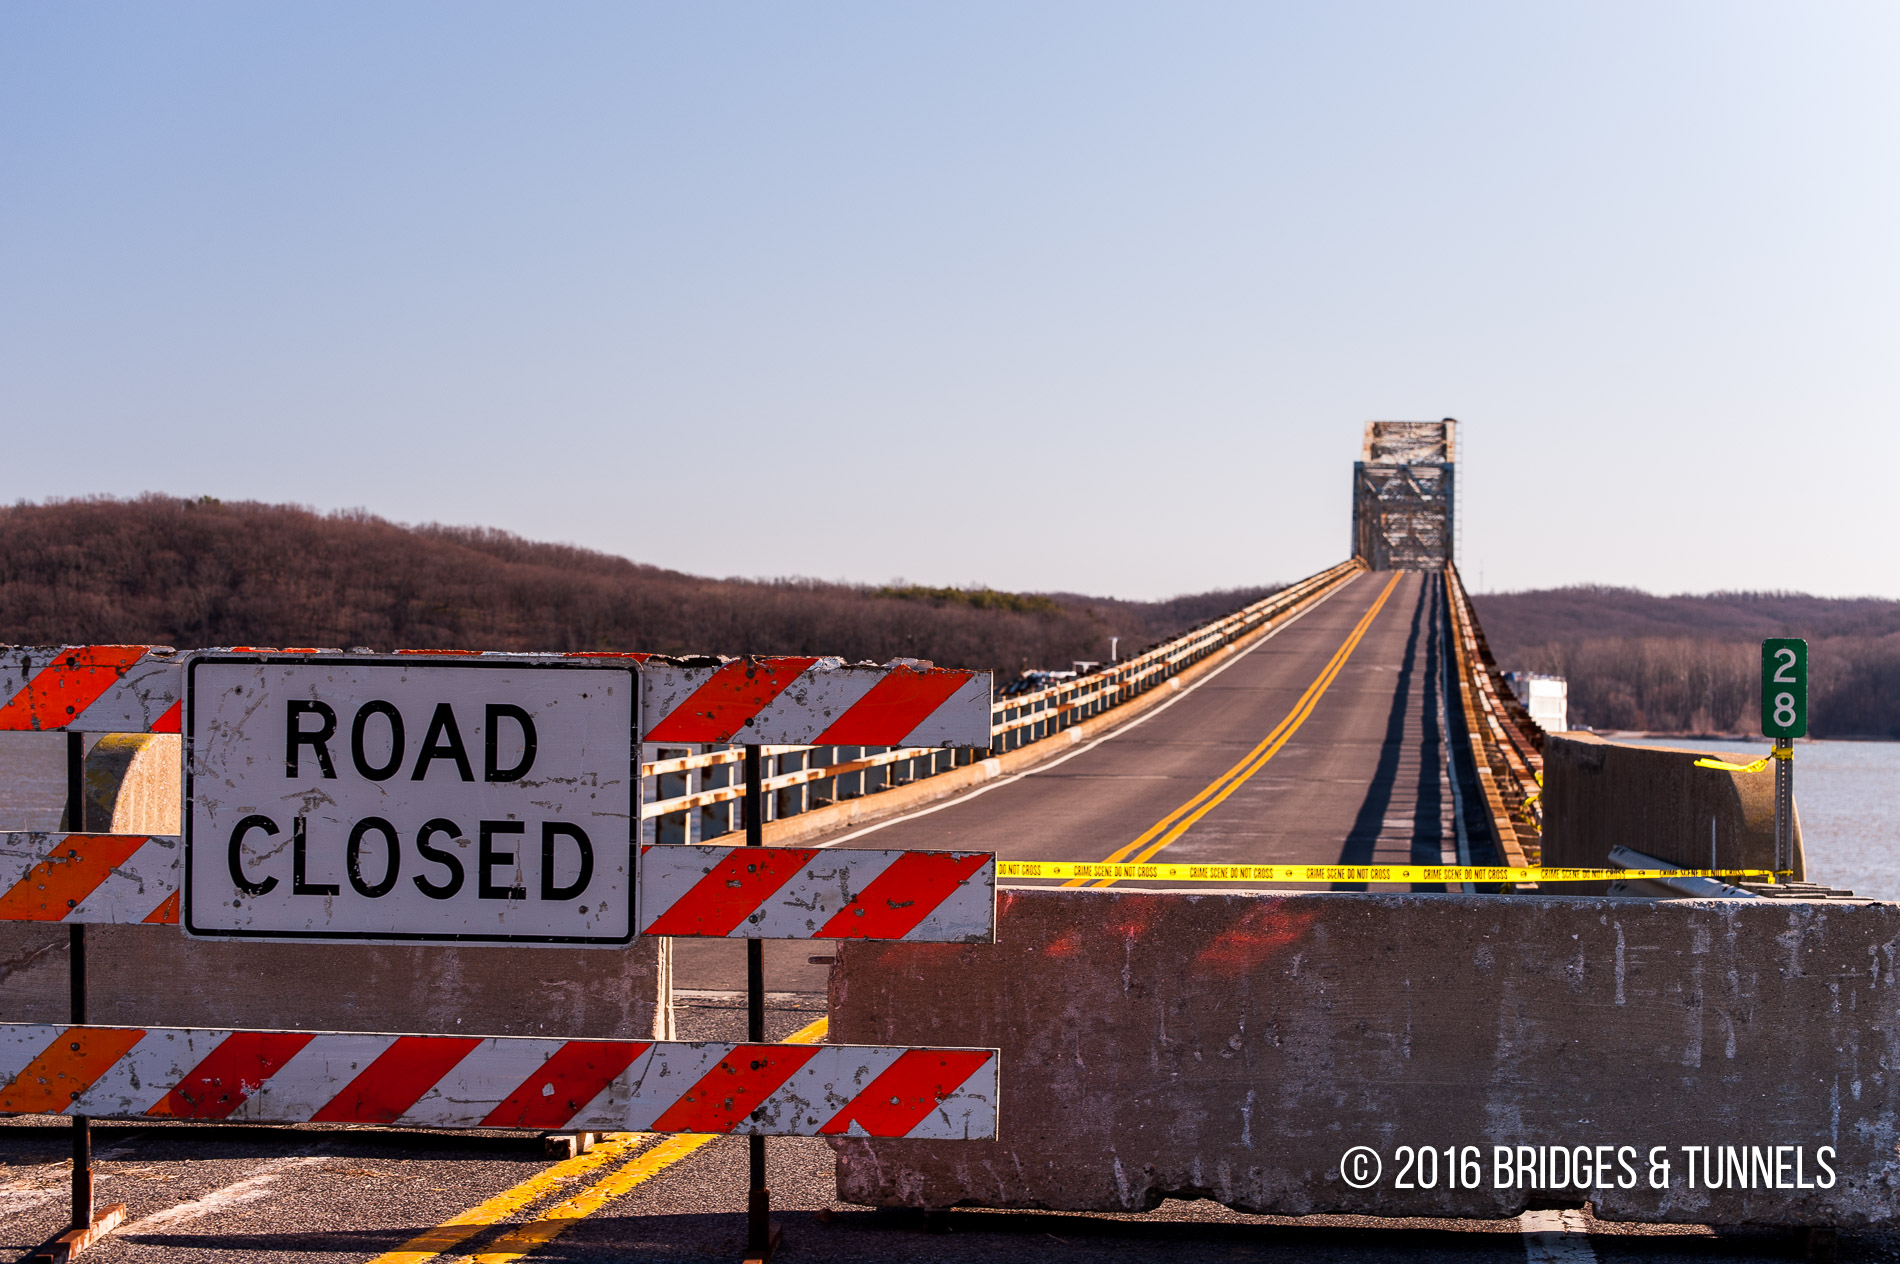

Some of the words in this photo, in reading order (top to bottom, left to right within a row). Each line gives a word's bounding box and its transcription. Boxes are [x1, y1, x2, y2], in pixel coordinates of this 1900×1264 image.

[285, 699, 538, 783] ROAD
[227, 814, 594, 901] CLOSED
[998, 864, 1006, 875] DO
[1008, 864, 1020, 876] NOT
[1022, 865, 1041, 876] CROSS
[1074, 865, 1092, 876] CRIME
[1094, 866, 1112, 877] SCENE
[1114, 866, 1123, 877] DO
[1124, 866, 1136, 877] NOT
[1138, 866, 1158, 878] CROSS
[1190, 867, 1208, 878] CRIME
[1210, 867, 1228, 878] SCENE
[1231, 867, 1238, 879] DO
[1240, 867, 1252, 879] NOT
[1254, 867, 1274, 879] CROSS
[1306, 868, 1325, 879] CRIME
[1327, 868, 1345, 879] SCENE
[1347, 868, 1355, 879] DO
[1357, 868, 1369, 879] NOT
[1371, 868, 1391, 879] CROSS
[1424, 869, 1442, 880] CRIME
[1444, 869, 1462, 880] SCENE
[1465, 869, 1472, 880] DO
[1474, 869, 1486, 880] NOT
[1488, 869, 1508, 880] CROSS
